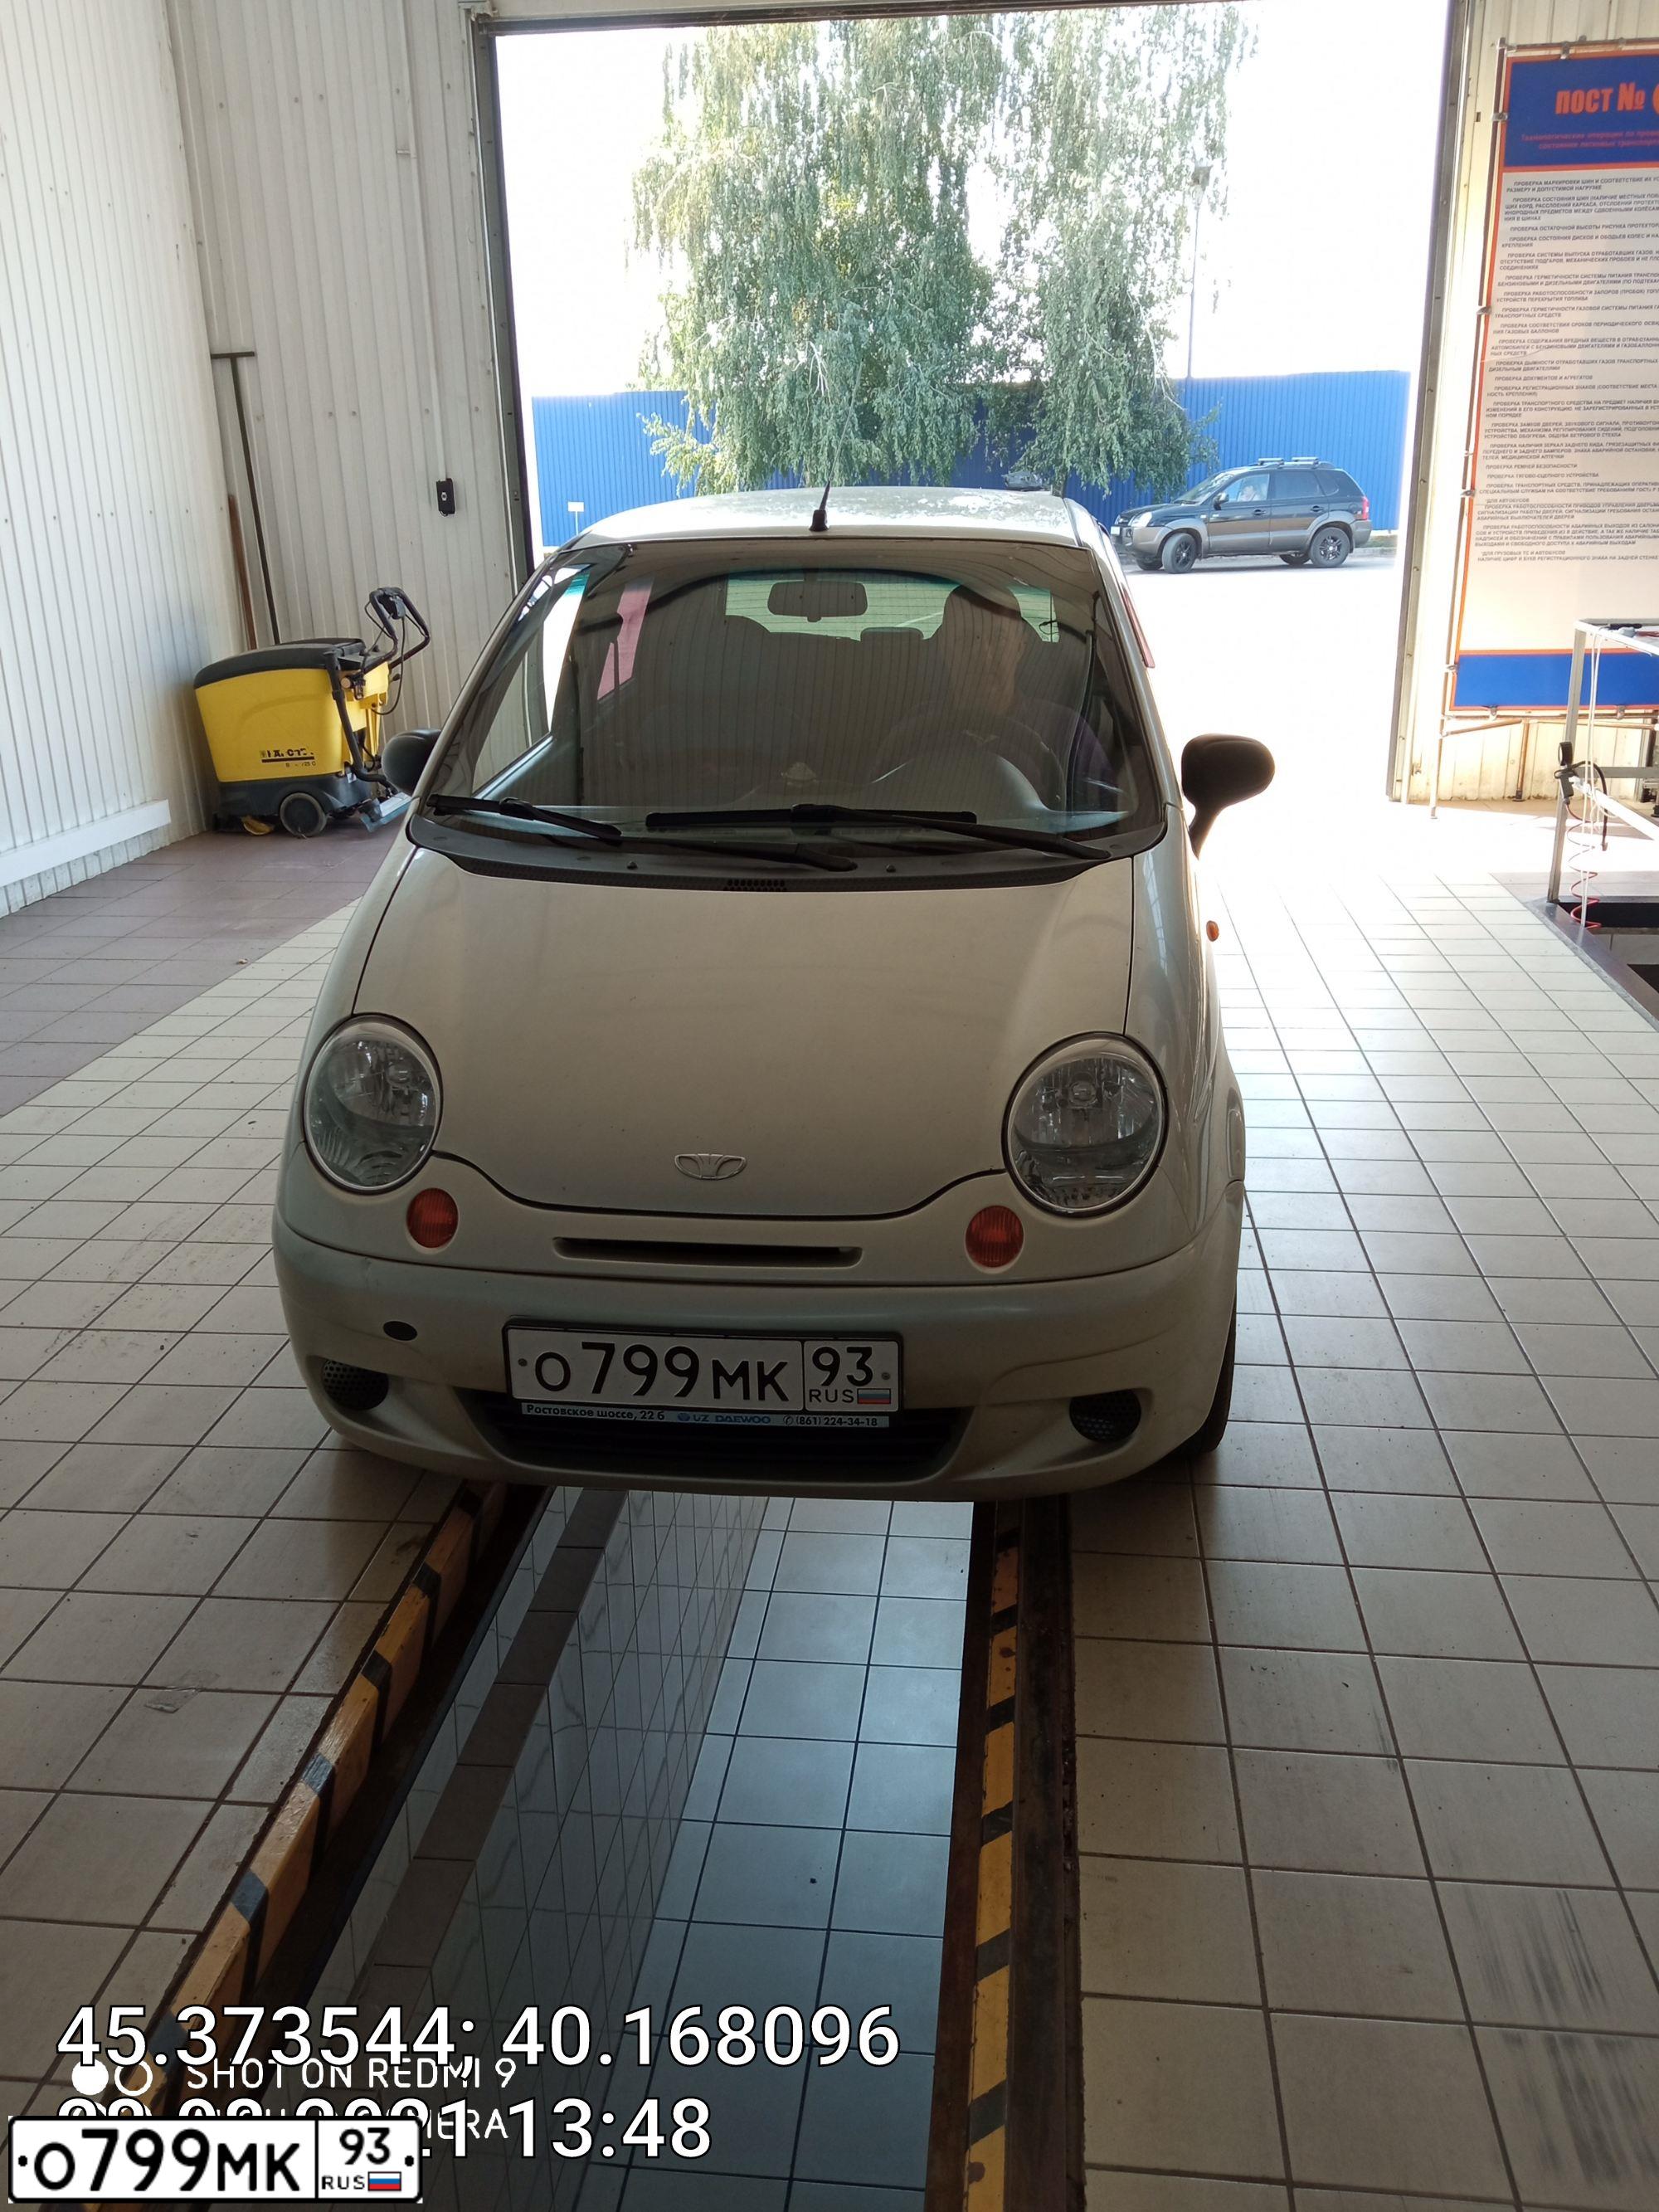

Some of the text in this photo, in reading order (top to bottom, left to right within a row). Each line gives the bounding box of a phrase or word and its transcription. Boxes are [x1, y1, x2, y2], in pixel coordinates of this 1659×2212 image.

[811, 1346, 873, 1386] 93
[809, 1388, 854, 1404] RUS
[526, 1403, 594, 1418] Ростовское
[596, 1408, 637, 1421] шоссе,
[640, 1410, 654, 1420] 22
[693, 1414, 771, 1425] UZ DAEWOO
[795, 1415, 878, 1427] (861) 224-34-18
